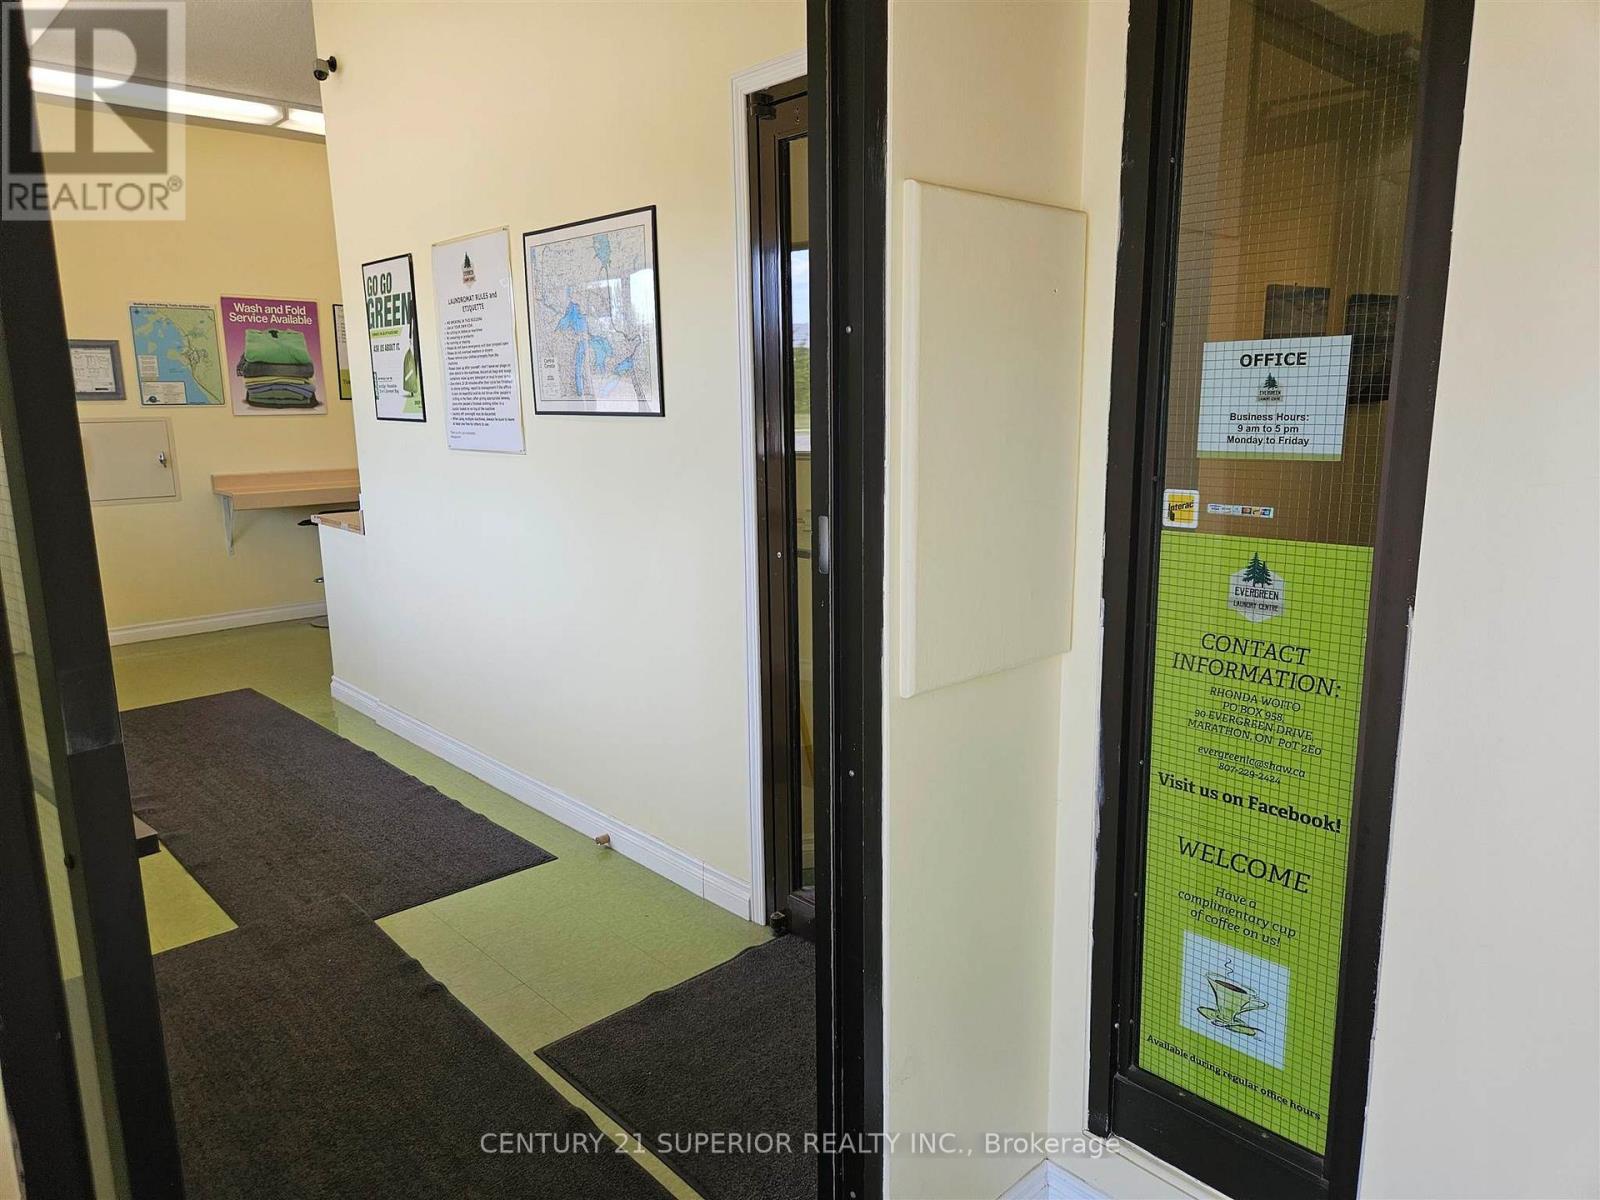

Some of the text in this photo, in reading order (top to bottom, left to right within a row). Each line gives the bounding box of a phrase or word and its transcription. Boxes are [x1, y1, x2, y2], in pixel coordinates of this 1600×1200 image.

[367, 272, 392, 298] GO GO
[448, 294, 474, 305] LAUNDROMAT
[475, 292, 488, 300] RULES
[462, 303, 484, 312] ETIQUETTE
[233, 302, 306, 315] Wash and Fold
[367, 292, 412, 329] GREEN
[229, 312, 312, 325] Service Available
[385, 343, 395, 351] ABOUT
[1240, 352, 1307, 367] OFFICE
[1230, 413, 1309, 422] Business Hours:
[1284, 426, 1299, 434] pm
[1227, 435, 1263, 446] Monday
[1279, 436, 1309, 447] Friday
[1168, 501, 1194, 512] Interac
[1235, 587, 1279, 600] EVERGREEN
[1233, 600, 1279, 612] LAUNDRY CENTRE
[1202, 633, 1311, 666] CONTACT
[1172, 652, 1342, 698] INFORMATION:
[1210, 687, 1301, 712] RHONDA WOITO
[1222, 702, 1237, 712] PO
[1240, 704, 1262, 718] BOX
[1194, 709, 1314, 741] 90 EVERGREEN DRIVE,
[1255, 733, 1273, 744] ON
[1198, 746, 1306, 778] evergreenlc@shaw.ca
[1218, 762, 1281, 785] 807-229-2424
[1158, 772, 1341, 833] Visit us on Facebook!
[1178, 835, 1311, 893] WELCOME
[1215, 886, 1257, 909] Have a
[1178, 890, 1296, 938] complimentary cup
[1190, 908, 1281, 947] of coffee on us!
[1146, 1034, 1321, 1120] Available during regular office hours
